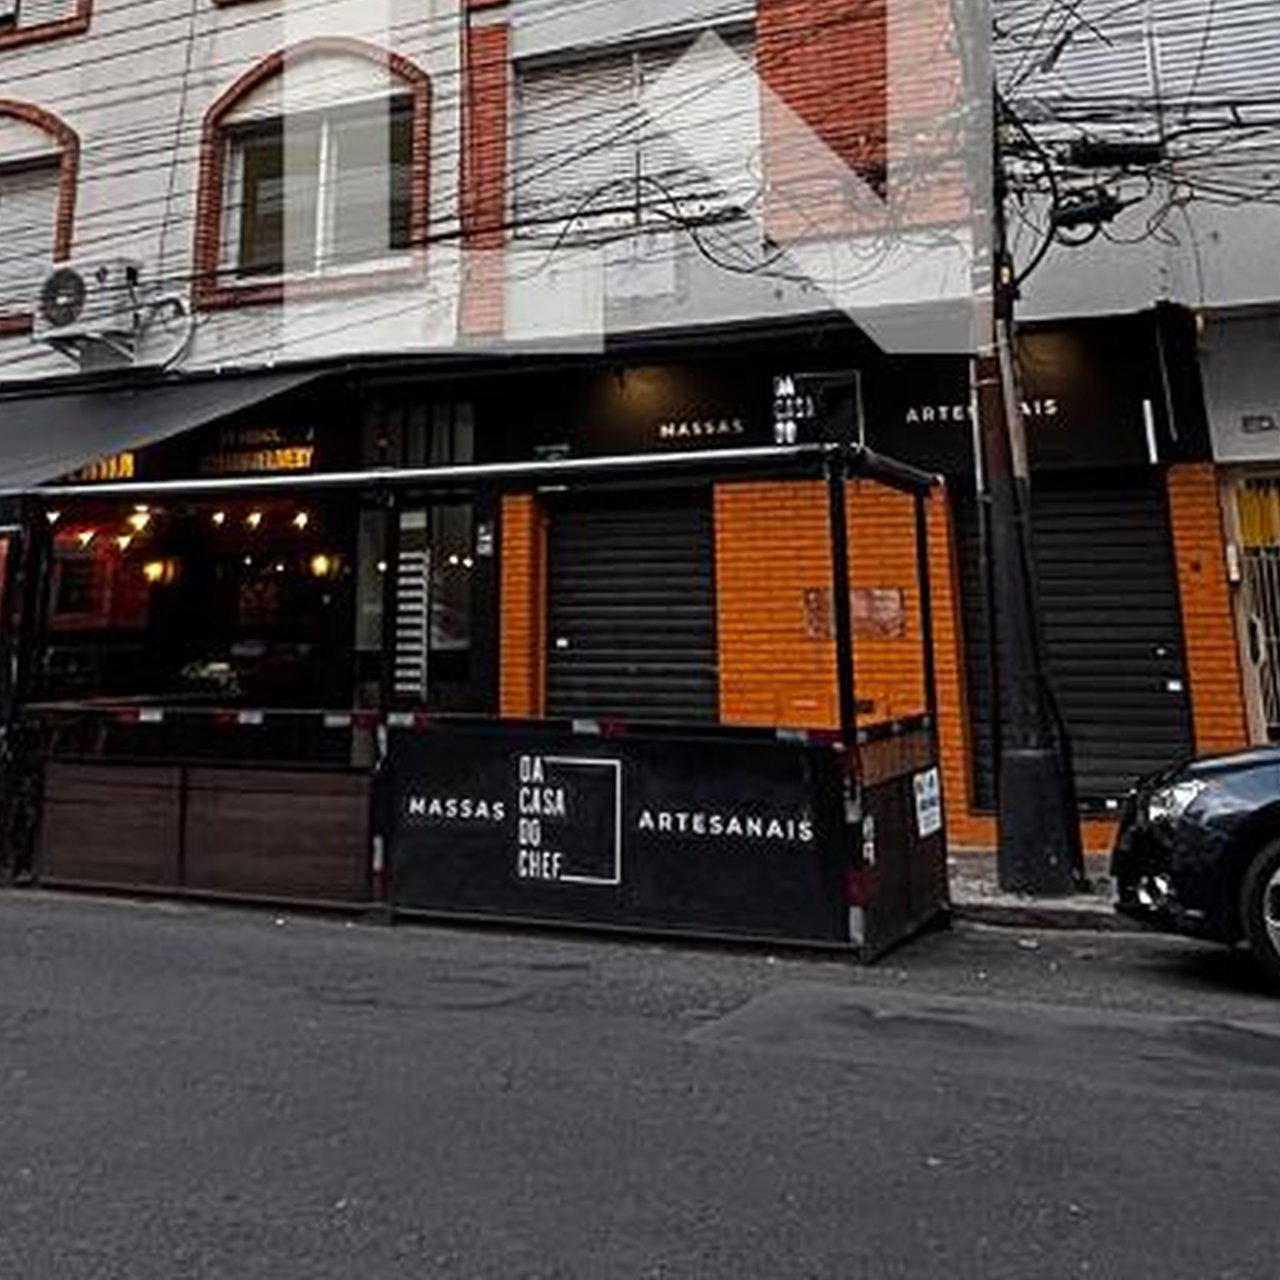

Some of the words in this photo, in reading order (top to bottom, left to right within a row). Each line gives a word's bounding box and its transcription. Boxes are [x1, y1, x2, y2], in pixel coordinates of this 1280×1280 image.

[905, 399, 1058, 422] ARTEAIS
[660, 419, 745, 438] MASSAS
[409, 797, 507, 821] MASSAS
[519, 787, 566, 815] CASA
[519, 819, 543, 847] DO
[638, 810, 815, 842] ARTESANAIS
[519, 850, 563, 878] CHEF
